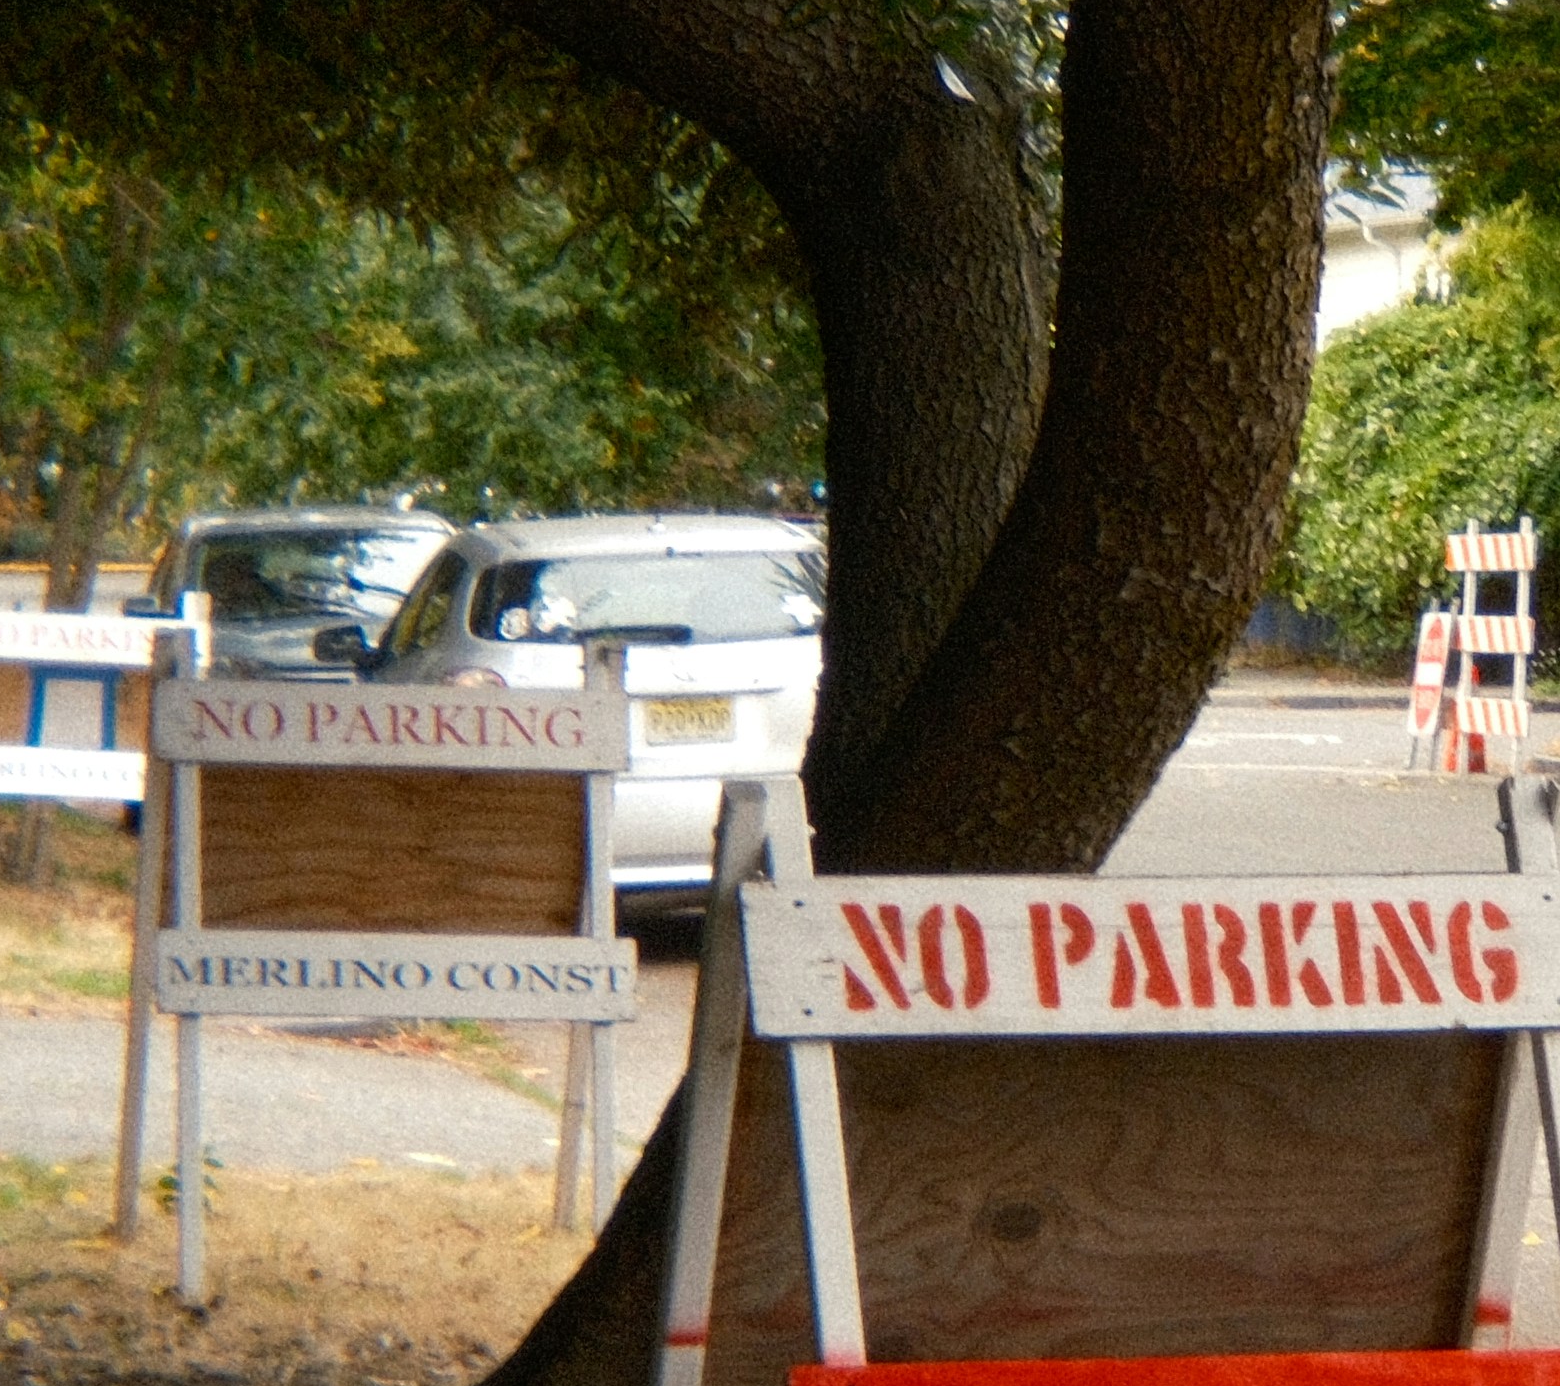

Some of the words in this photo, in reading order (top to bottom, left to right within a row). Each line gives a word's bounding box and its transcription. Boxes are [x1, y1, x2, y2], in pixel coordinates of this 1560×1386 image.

[191, 698, 287, 742] NO
[305, 700, 586, 749] PARKING
[167, 954, 434, 990] MERLINO
[446, 959, 629, 995] CONST
[838, 901, 992, 1011] NO
[1028, 899, 1518, 1010] PARKING
